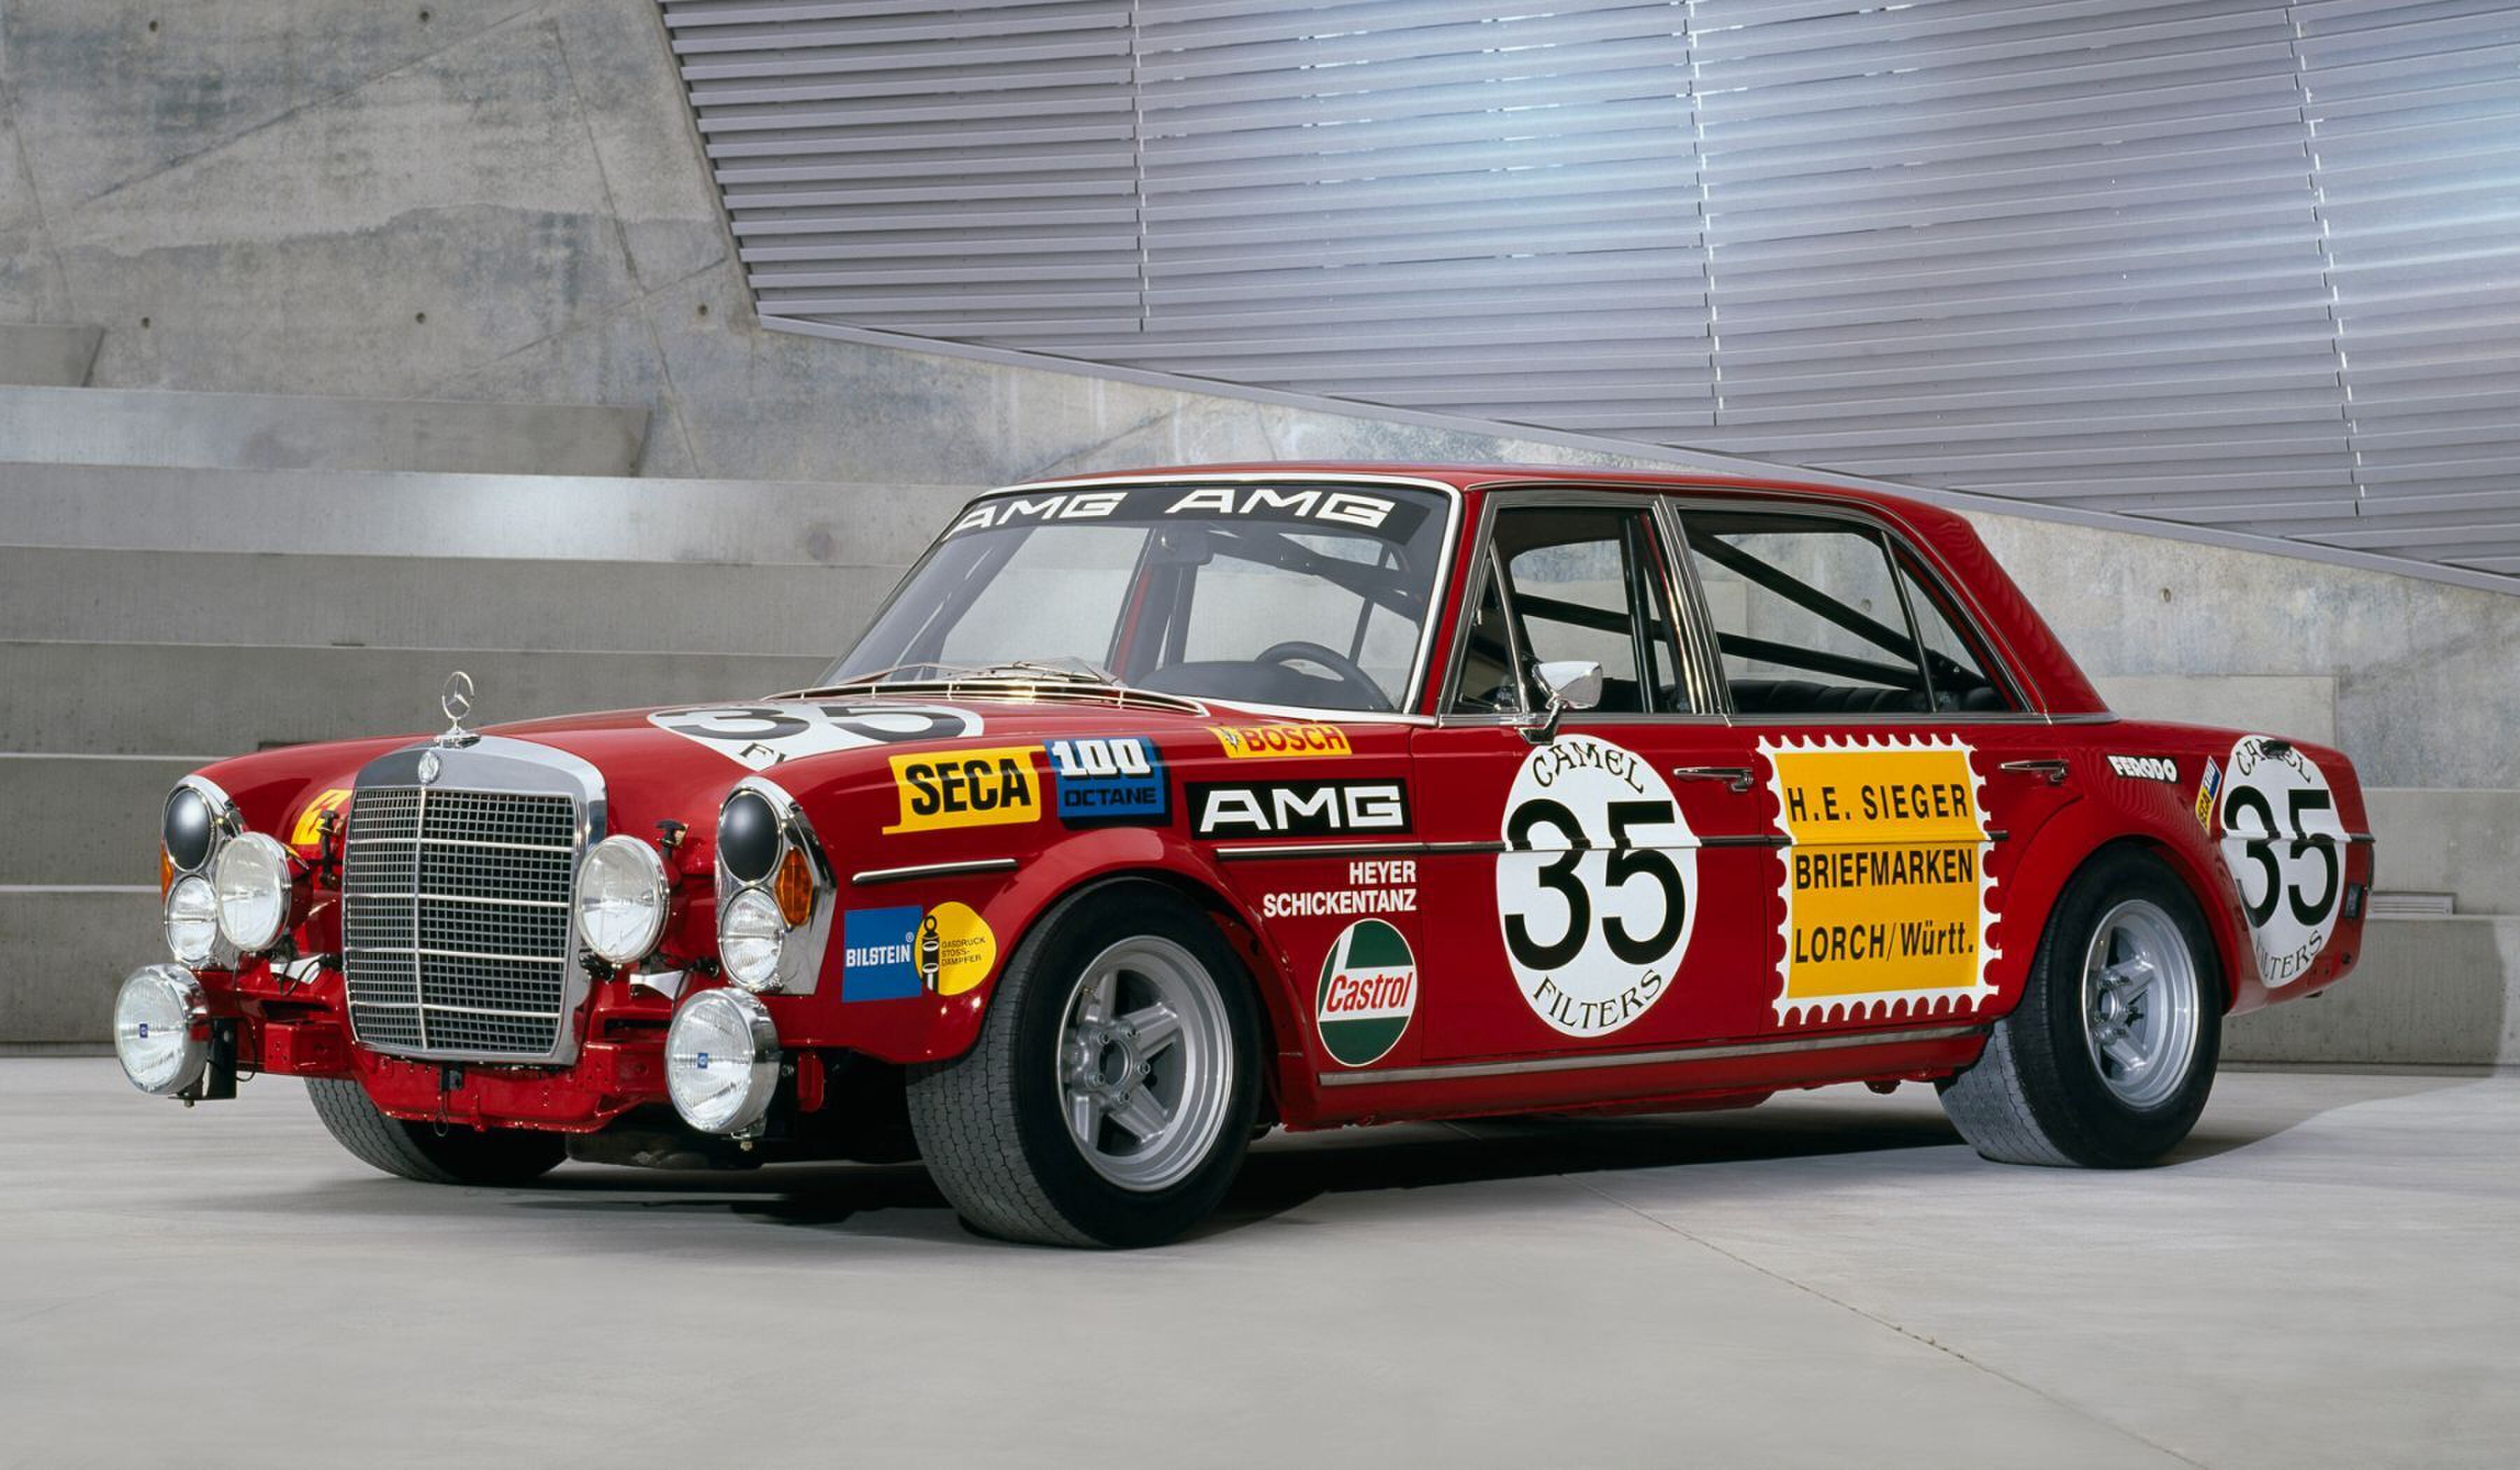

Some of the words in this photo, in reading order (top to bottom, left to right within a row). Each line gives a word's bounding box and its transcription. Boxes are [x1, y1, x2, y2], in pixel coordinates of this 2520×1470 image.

[941, 492, 1128, 542] AMG
[1164, 489, 1396, 528] AMG
[657, 705, 967, 743] 35
[1238, 726, 1345, 751] BOSCH
[1051, 738, 1152, 778] 100
[1532, 741, 1645, 794] CAMEL
[2106, 755, 2178, 783] FERODO
[905, 759, 1032, 816] SECA
[1063, 786, 1156, 807] OCTANE
[1787, 786, 1851, 822] H.E.
[1861, 783, 1968, 820] SIEGER
[1199, 785, 1404, 832] AMG
[1349, 860, 1417, 886] HEYER
[1795, 849, 1973, 890] BRIEFMARKEN
[2224, 785, 2339, 928] 35
[1263, 888, 1418, 918] SCHICKENTANZ
[1504, 798, 1686, 971] 35
[846, 944, 911, 967] BILSTEIN
[1795, 920, 1974, 964] LORCH/Württ.
[1326, 972, 1413, 1013] Castrol
[1533, 969, 1662, 1030] FILTERS
